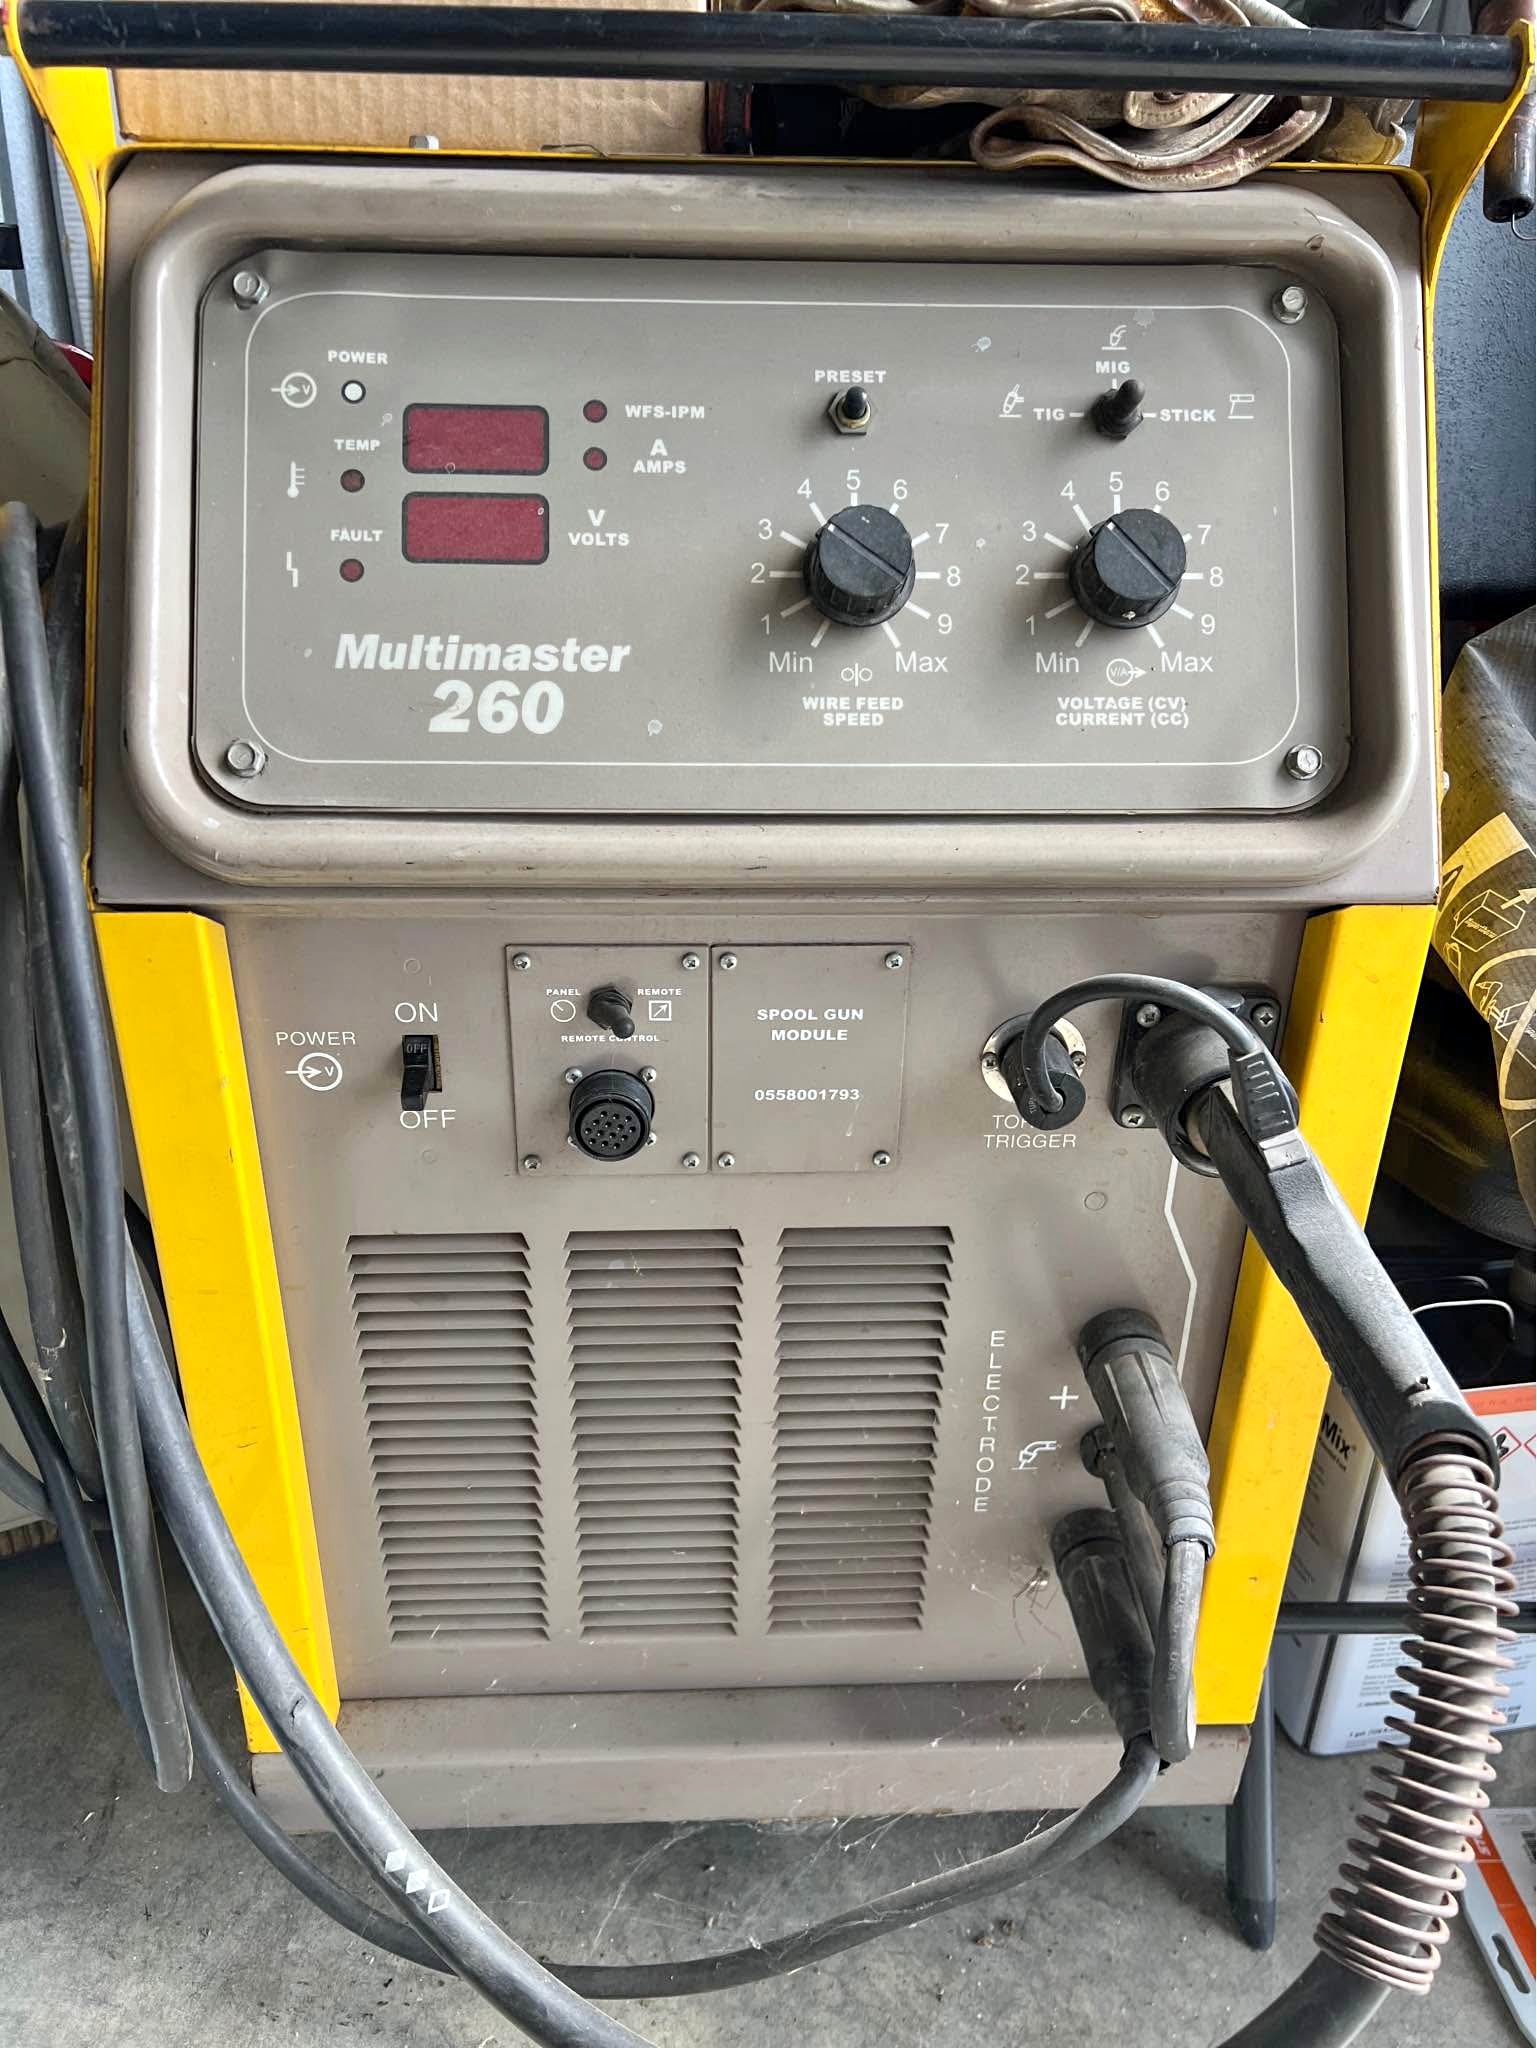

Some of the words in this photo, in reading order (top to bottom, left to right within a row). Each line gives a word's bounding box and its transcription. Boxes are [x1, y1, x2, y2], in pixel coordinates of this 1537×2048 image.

[327, 349, 388, 365] POWER
[1095, 360, 1131, 374] MIG
[814, 369, 887, 384] PRESET
[624, 404, 705, 419] WFS-IPM
[1032, 407, 1065, 421] TIG
[1159, 408, 1217, 422] STICK
[333, 438, 381, 451] TEMP
[650, 438, 668, 457] A
[632, 459, 687, 474] AMPS
[796, 478, 813, 499] 4
[846, 469, 861, 491] 5
[893, 478, 908, 501] 6
[1109, 471, 1124, 493] 5
[1060, 480, 1076, 501] 4
[1155, 480, 1170, 502] 6
[587, 508, 606, 527] V
[330, 527, 384, 542] FAULT
[758, 518, 773, 540] 3
[935, 523, 950, 544] 7
[1022, 520, 1037, 542] 3
[1197, 524, 1212, 545] 7
[567, 532, 630, 547] VOLTS
[751, 562, 765, 584] 2
[946, 565, 961, 587] 8
[1015, 563, 1030, 585] 2
[1209, 566, 1224, 588] 8
[761, 614, 770, 635] 1
[937, 613, 953, 635] 9
[1025, 615, 1035, 636] 1
[1200, 613, 1216, 636] 9
[335, 633, 632, 673] Multimaster
[769, 651, 813, 673] Min
[895, 650, 948, 673] Max
[1036, 652, 1080, 673] Min
[1161, 651, 1214, 673] Max
[428, 679, 565, 735] 260
[802, 696, 851, 711] WIRE
[856, 696, 904, 711] FEED
[1057, 696, 1143, 710] VOLTAGE
[1148, 695, 1187, 713] (CV)
[823, 712, 884, 726] SPEED
[1055, 712, 1146, 726] CURRENT
[1150, 710, 1189, 729] (CC)
[546, 987, 583, 997] PANEL
[637, 988, 682, 996] REMOTE
[394, 1002, 438, 1023] ON
[756, 1008, 819, 1021] SPOOL
[823, 1008, 864, 1021] GUN
[275, 1031, 356, 1046] POWER
[561, 1034, 606, 1043] REMOTE
[771, 1029, 849, 1041] MODULE
[406, 1043, 428, 1054] OFF
[754, 1088, 860, 1101] 0558001793
[399, 1109, 457, 1129] OFF
[983, 1133, 1077, 1149] TRIGGER
[974, 1330, 1006, 1512] ELECTRODE
